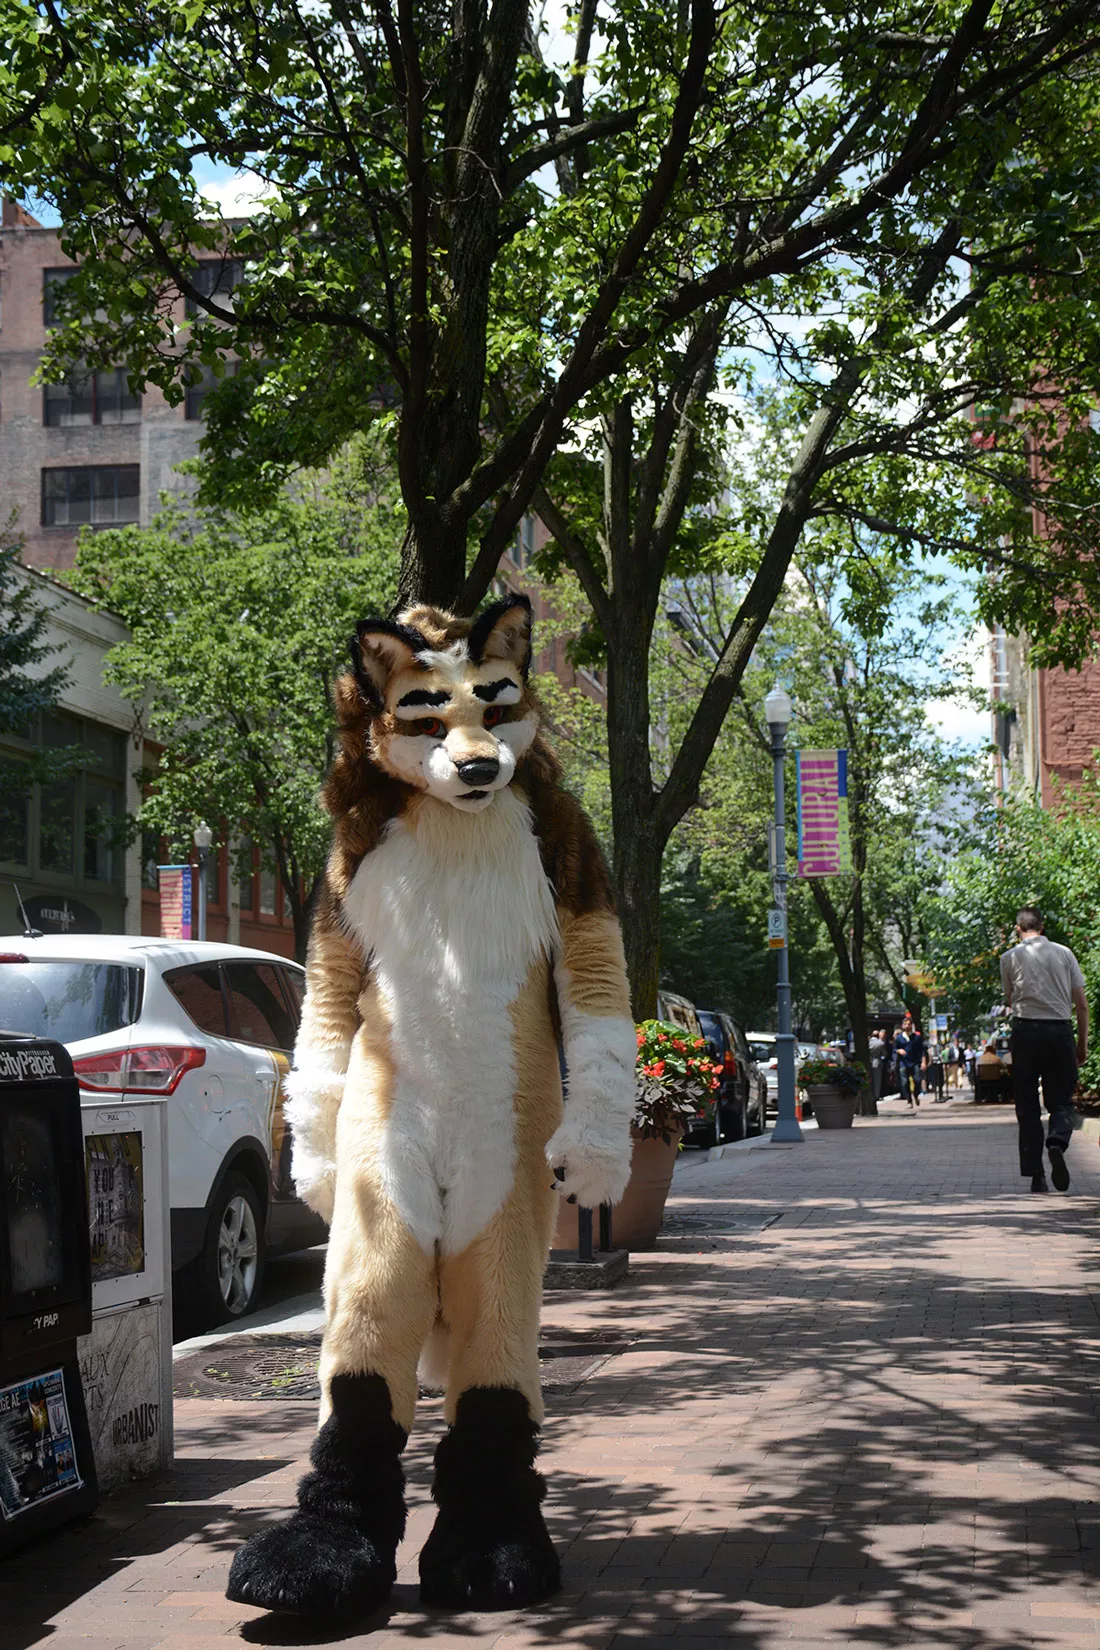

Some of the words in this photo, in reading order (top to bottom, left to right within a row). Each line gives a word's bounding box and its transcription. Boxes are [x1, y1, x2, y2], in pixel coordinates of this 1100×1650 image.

[800, 761, 839, 877] CULTURAL
[160, 869, 183, 939] ULTURAL
[43, 1312, 59, 1328] PAP
[80, 1352, 110, 1383] AUX
[0, 1396, 11, 1413] GE
[113, 1403, 159, 1445] URBANIST
